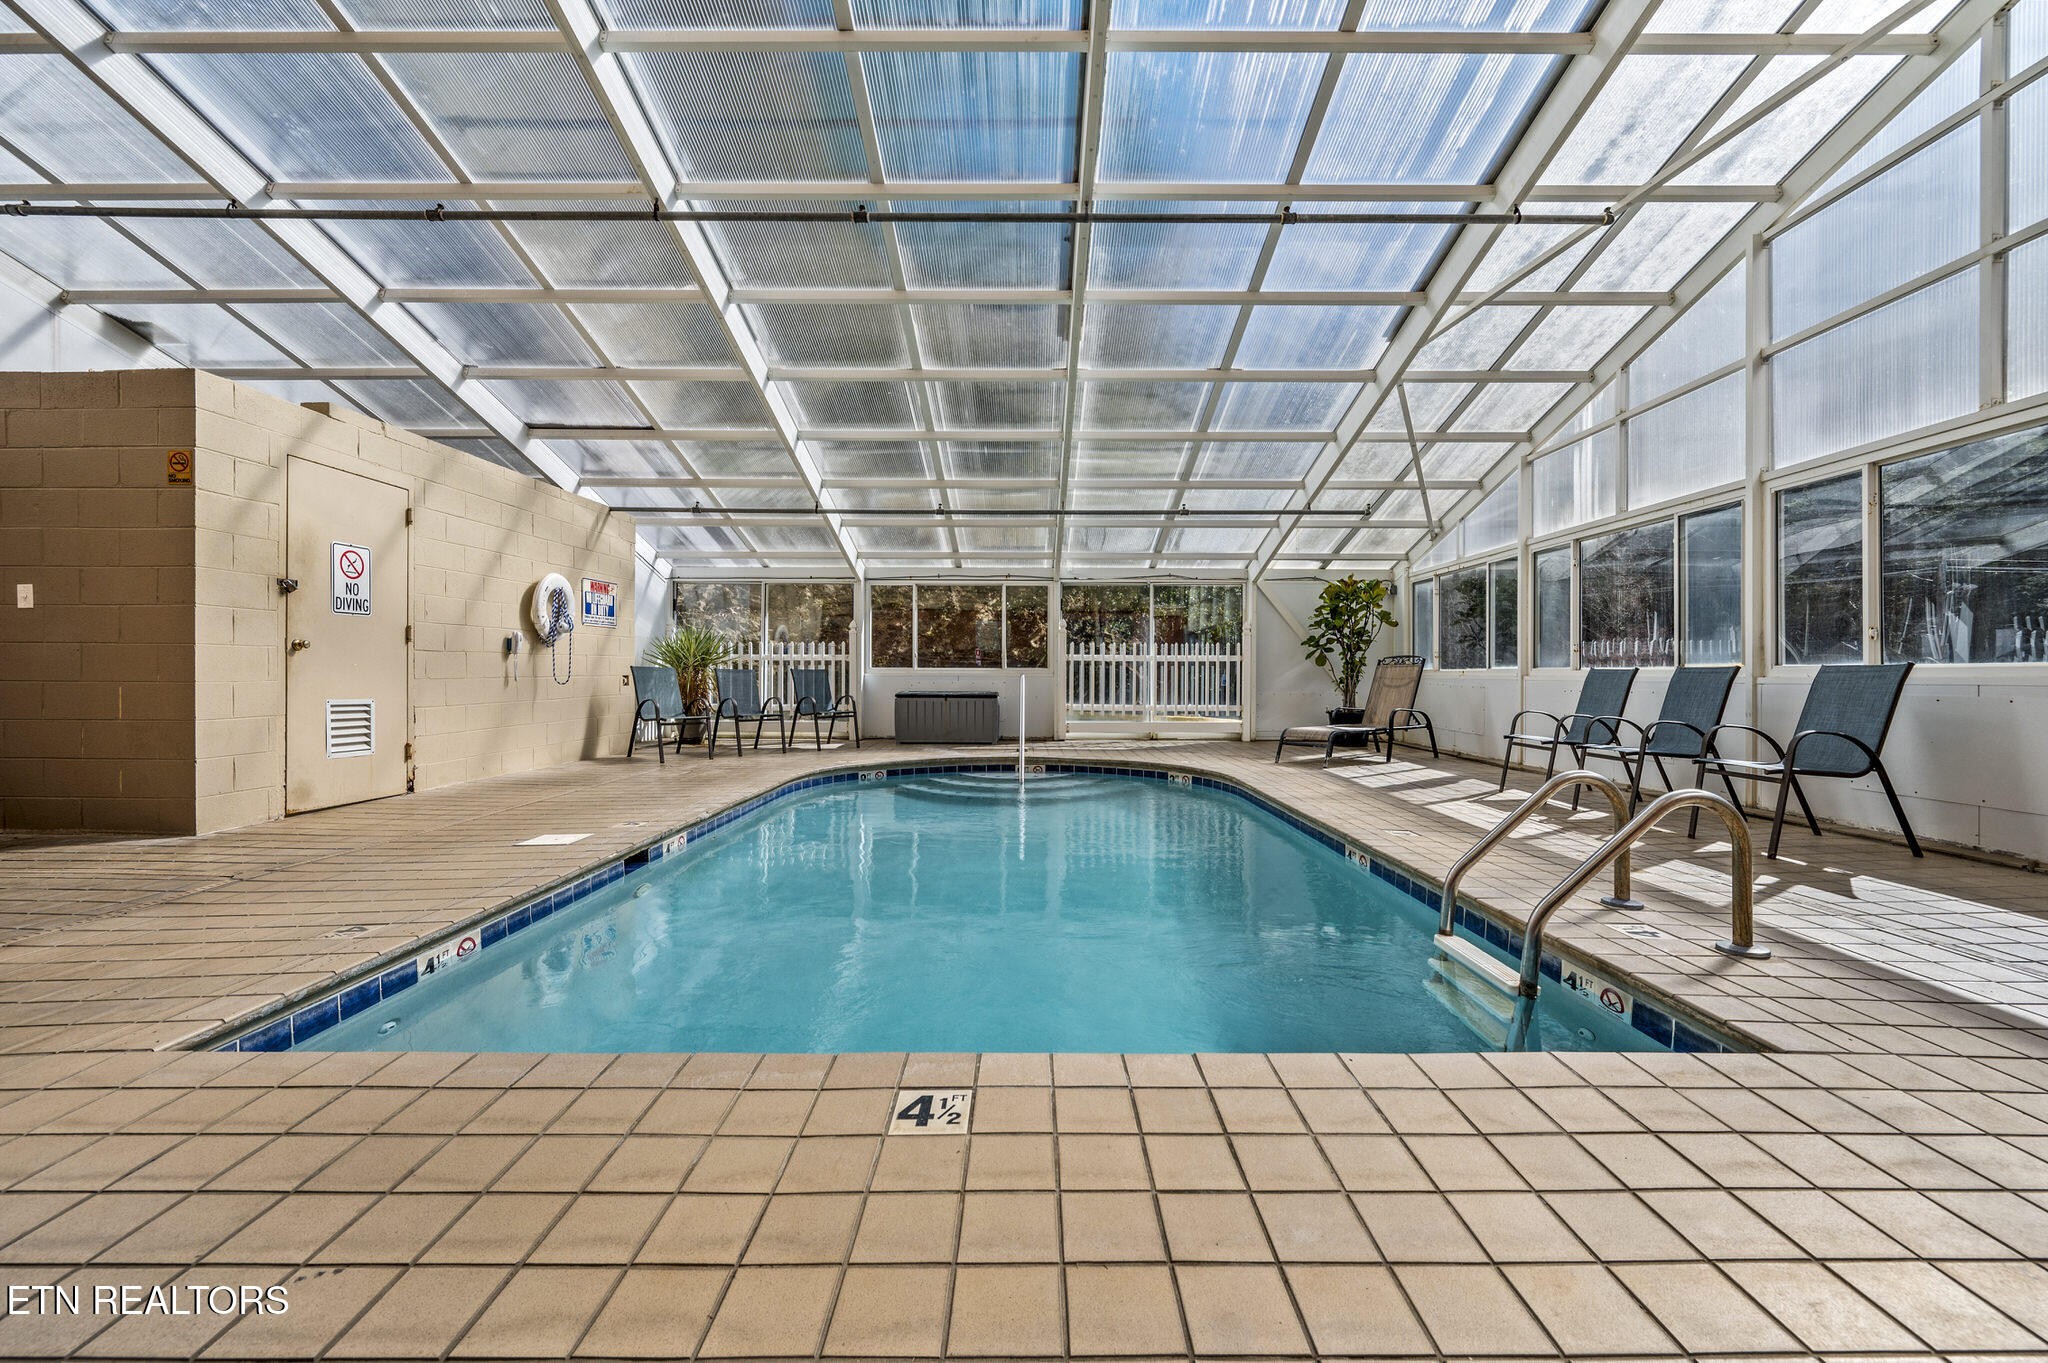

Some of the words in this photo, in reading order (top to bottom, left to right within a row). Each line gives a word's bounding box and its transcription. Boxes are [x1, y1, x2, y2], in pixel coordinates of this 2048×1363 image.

[345, 582, 360, 596] NO
[335, 596, 369, 613] DIVING
[951, 1094, 968, 1102] FT
